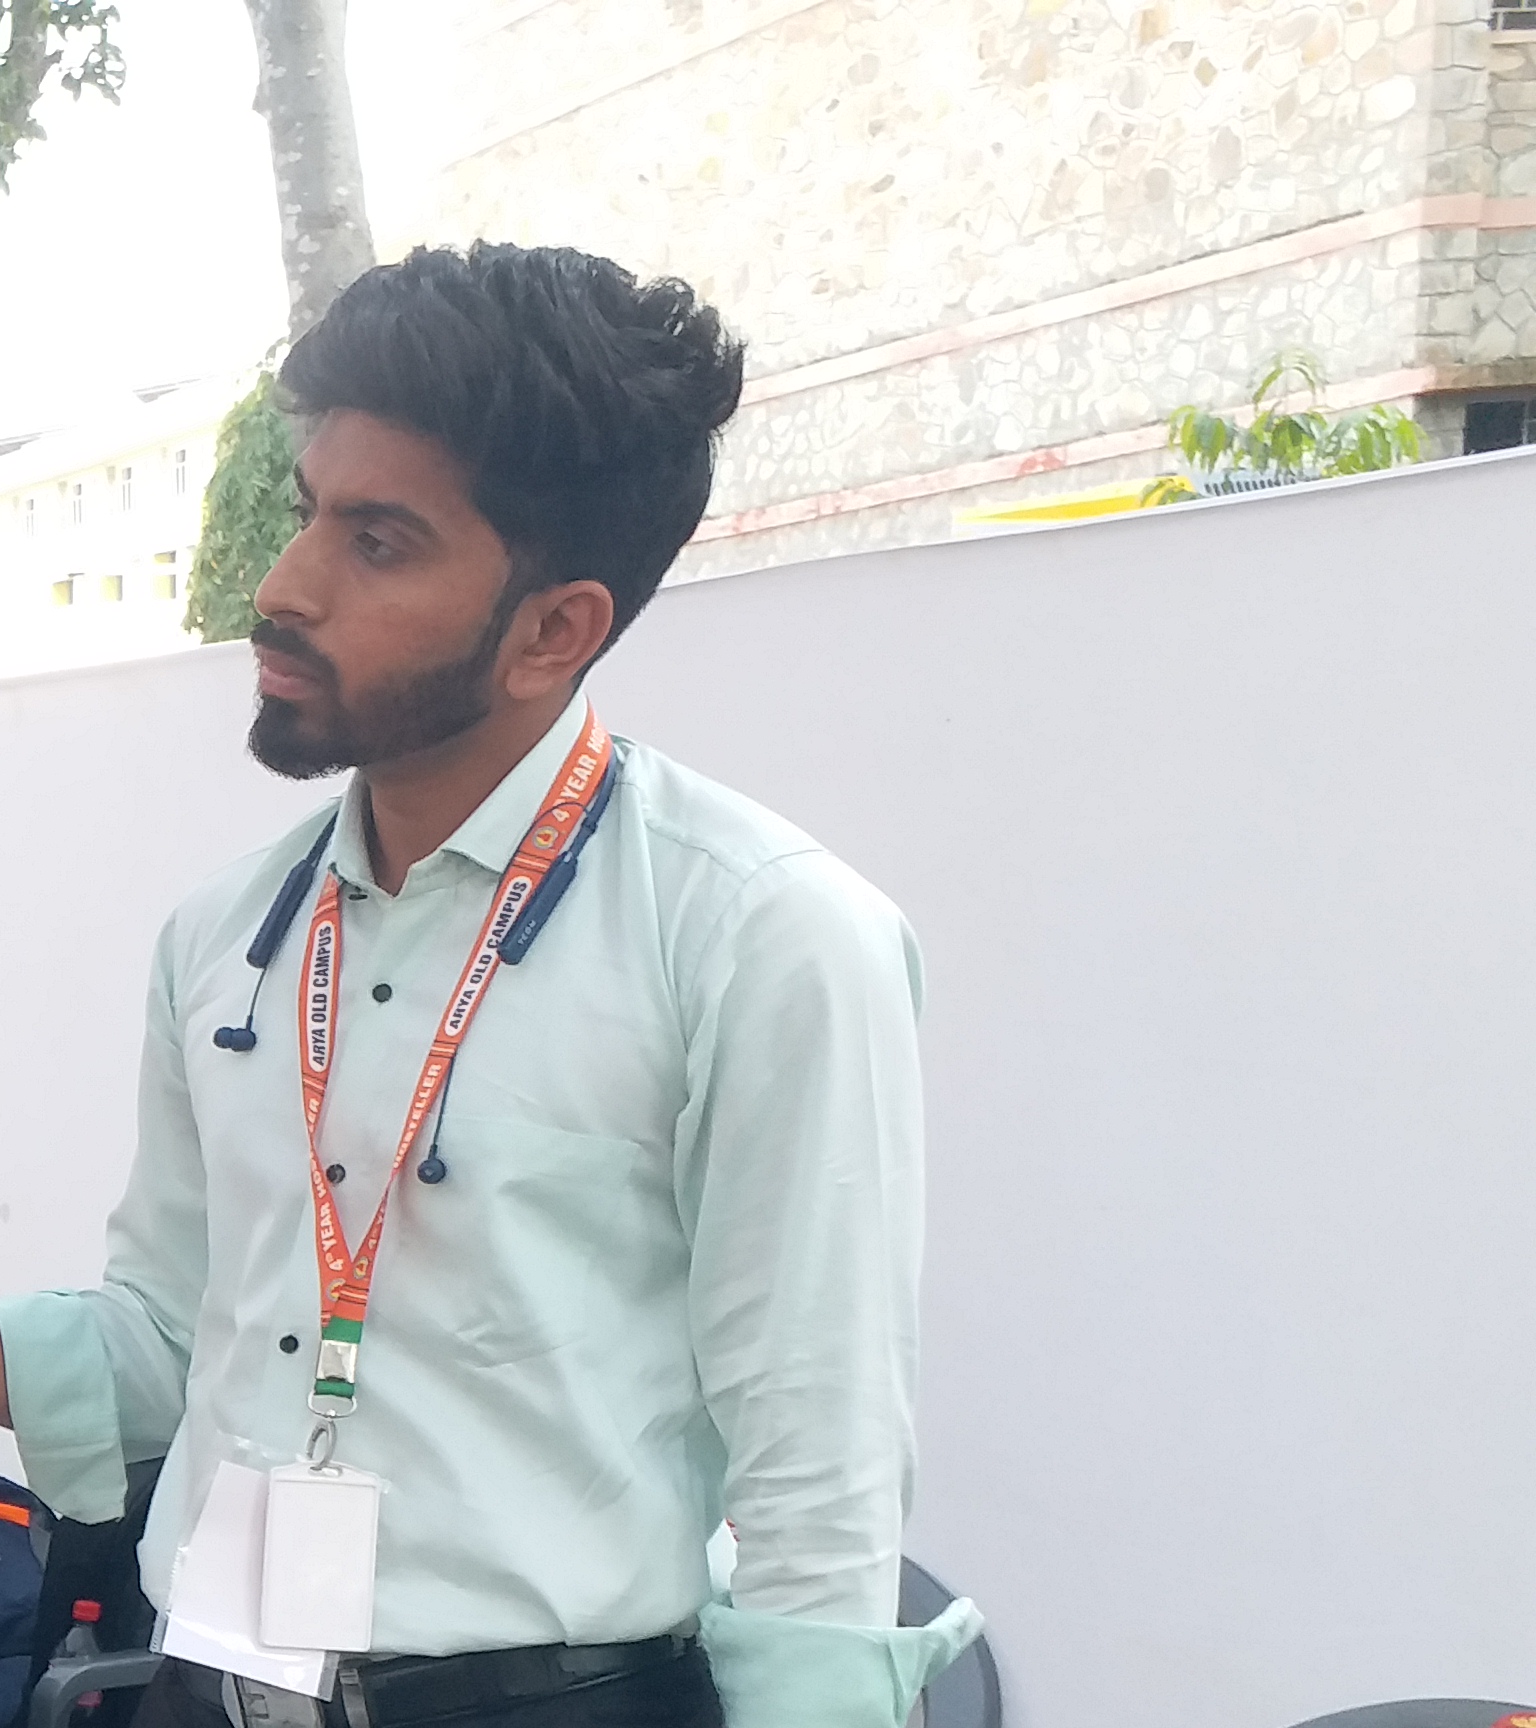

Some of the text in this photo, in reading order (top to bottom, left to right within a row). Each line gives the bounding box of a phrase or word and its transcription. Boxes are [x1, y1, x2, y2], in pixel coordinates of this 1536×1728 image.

[560, 753, 598, 800] YEAR
[311, 925, 332, 1067] ARYA OLD CAMPUS
[449, 989, 476, 1030] ARYA
[469, 954, 493, 985] OLD
[486, 880, 528, 950] CAMPUS
[320, 1203, 338, 1252] YEAR
